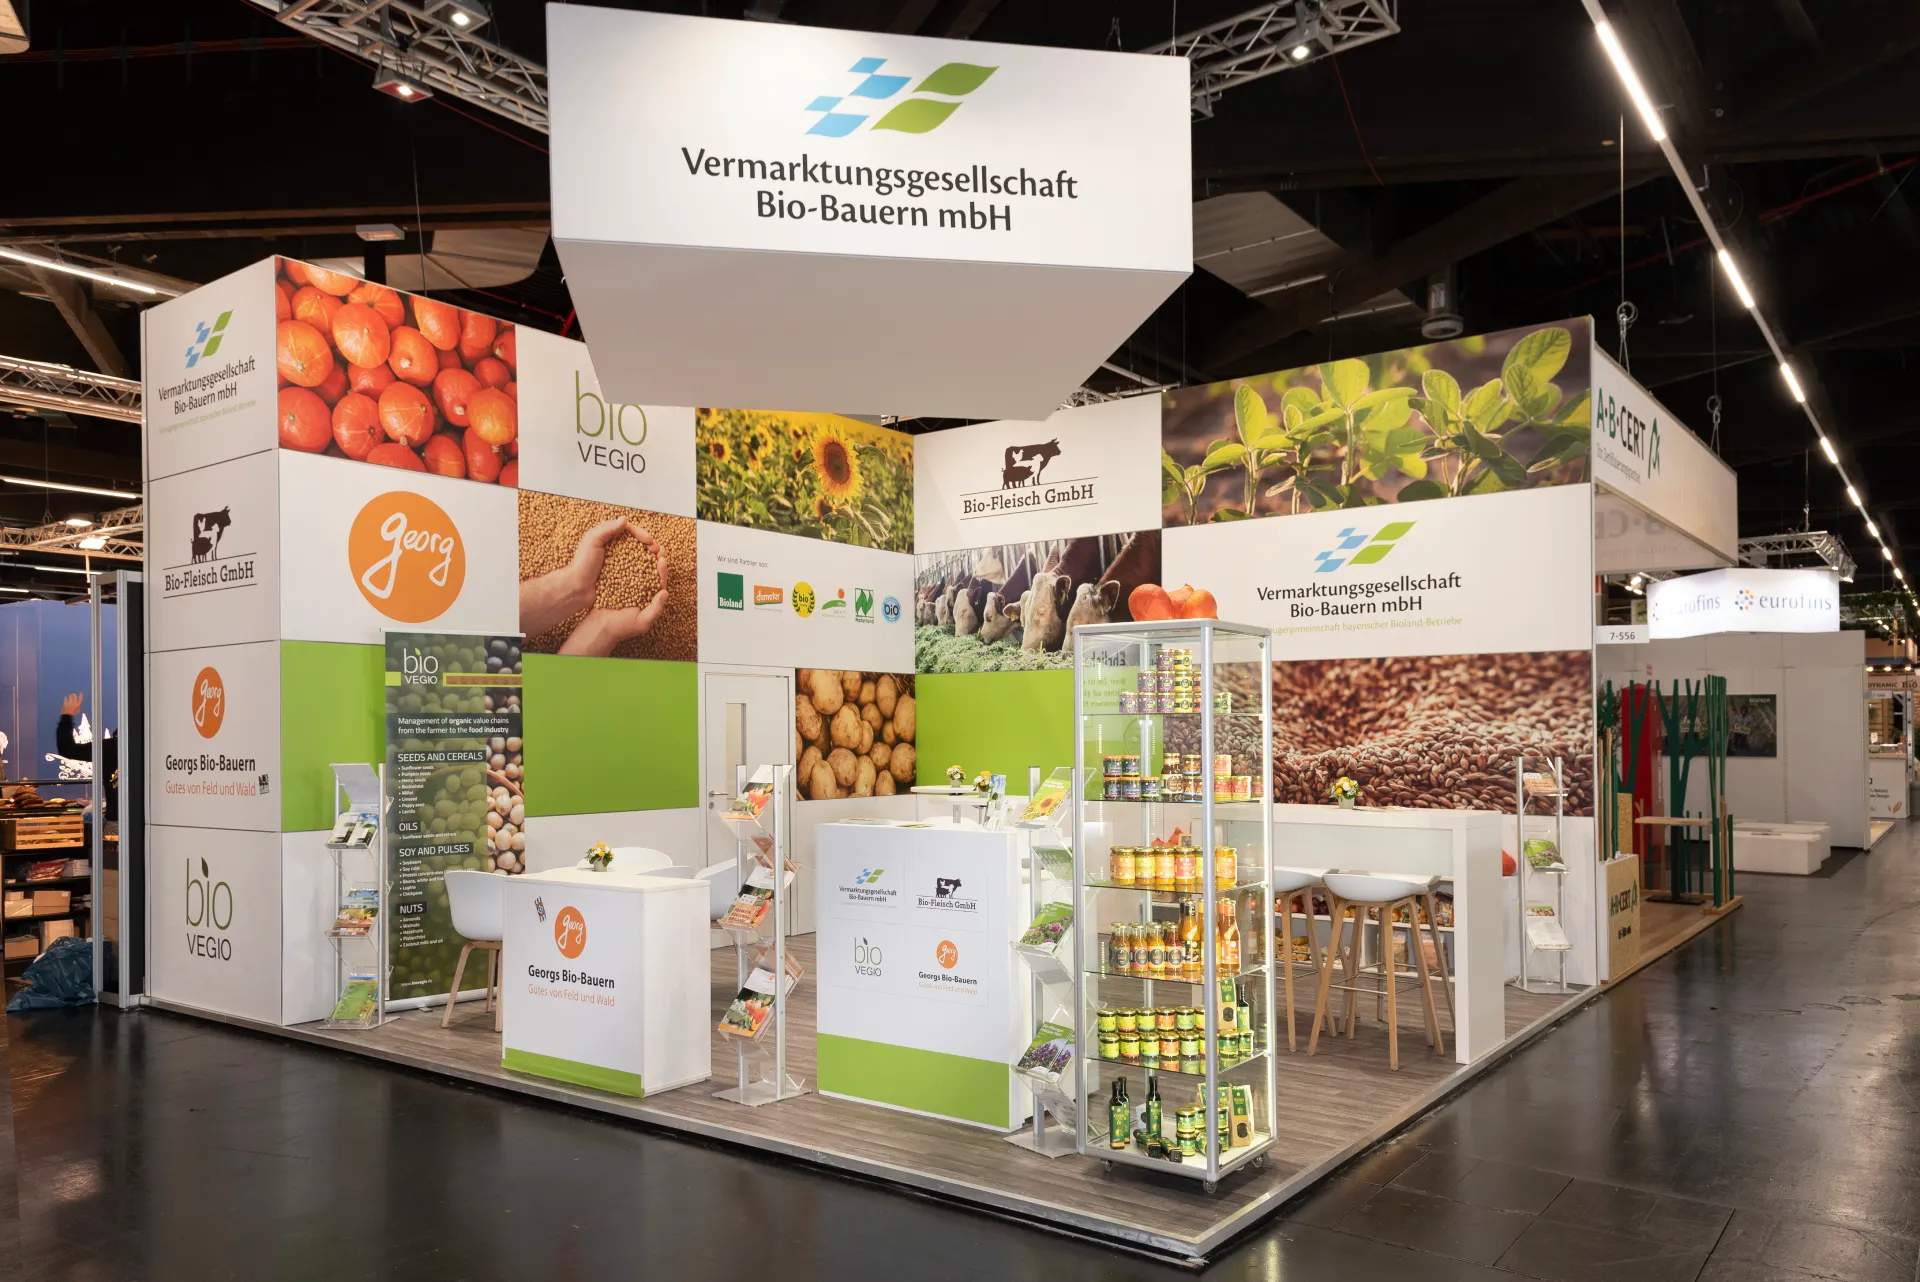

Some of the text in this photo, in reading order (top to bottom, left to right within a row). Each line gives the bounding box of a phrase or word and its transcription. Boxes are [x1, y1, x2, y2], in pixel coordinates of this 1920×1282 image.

[681, 146, 1079, 200] Vermarktungsgesellschaft
[756, 190, 1012, 232] Bio-Bauern mbH
[158, 356, 256, 402] Vermarktungsgesellschaft
[174, 382, 238, 415] Bio-Bauern mbH
[576, 370, 647, 446] bio
[578, 441, 646, 474] VEGIO
[963, 484, 1094, 514] Bio-Fleisch GmbH
[362, 512, 454, 599] georg
[164, 560, 254, 591] Bio-Fleisch GmbH
[1256, 572, 1462, 600] Vermarktungsgesellschaft
[719, 596, 743, 609] Bioland
[756, 590, 780, 601] demeter
[798, 594, 808, 603] bio
[1759, 594, 1832, 610] eurofins
[1290, 596, 1422, 618] Bio-Bauern mbH
[1342, 620, 1389, 632] bayerischer
[1390, 616, 1463, 628] Bioland-Betriebe
[1610, 632, 1636, 640] 7-556
[404, 648, 438, 674] bio
[404, 675, 438, 685] VEGIO
[195, 678, 222, 728] georg
[398, 718, 440, 726] Management
[166, 754, 256, 775] Georgs Bio-Bauern
[398, 752, 484, 762] SEEDS AND CEREALS
[166, 780, 256, 796] Gutes von Feld und Wald
[399, 822, 418, 831] OILS
[399, 844, 470, 857] SOY AND PULSES
[186, 856, 232, 930] bio
[838, 886, 897, 896] Vermarktungsgesellschaft
[400, 903, 423, 914] NUTS
[918, 898, 976, 910] Bio-Fleisch GmbH
[558, 914, 583, 949] georg
[186, 932, 232, 961] VEGIO
[854, 937, 882, 965] bio
[528, 964, 615, 989] Georgs Bio-Bauern
[854, 966, 882, 977] VEGIO
[918, 971, 978, 985] Georgs Bio-Bauern
[528, 983, 615, 1007] Gutes von Feld und Wald
